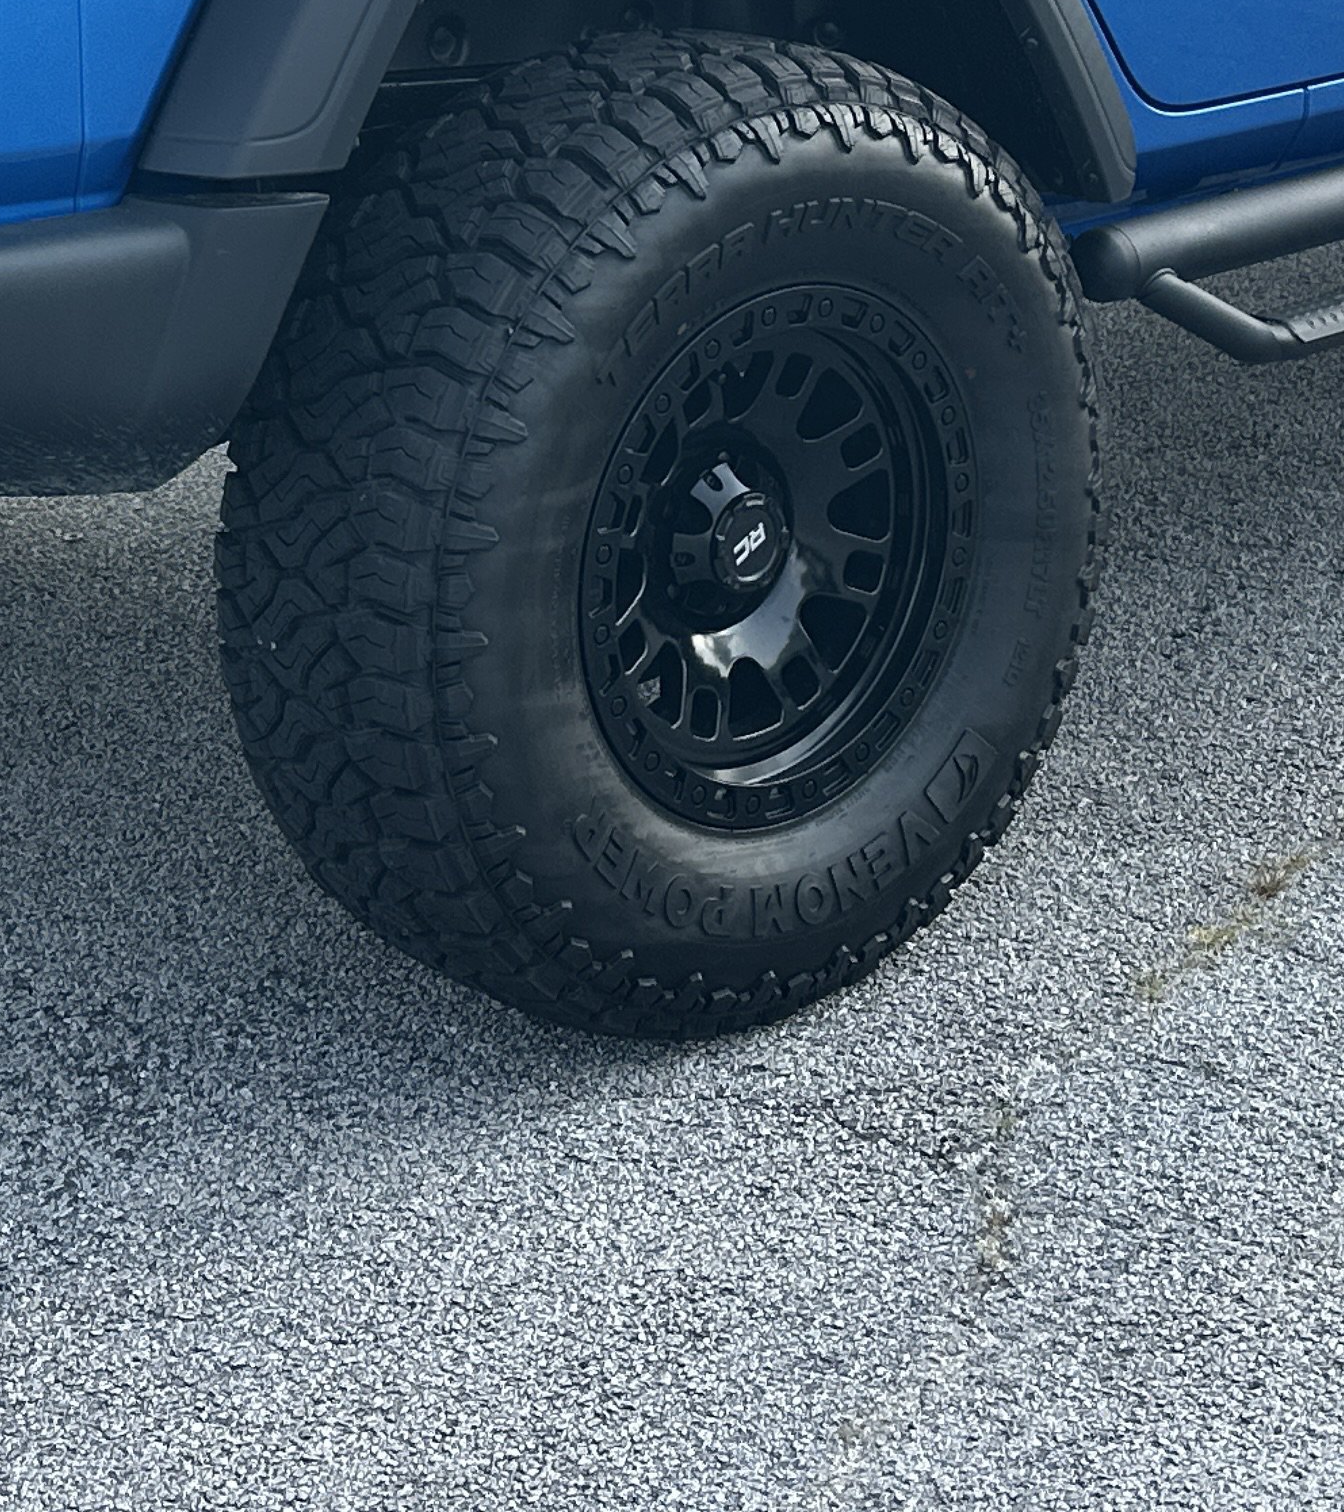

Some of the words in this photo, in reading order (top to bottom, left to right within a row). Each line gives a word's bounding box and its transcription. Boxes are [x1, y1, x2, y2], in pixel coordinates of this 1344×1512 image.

[594, 221, 755, 387] TERRA
[760, 197, 964, 265] HUNTER
[733, 522, 766, 566] RC
[572, 800, 734, 937] POWER
[750, 811, 942, 937] VENOM
